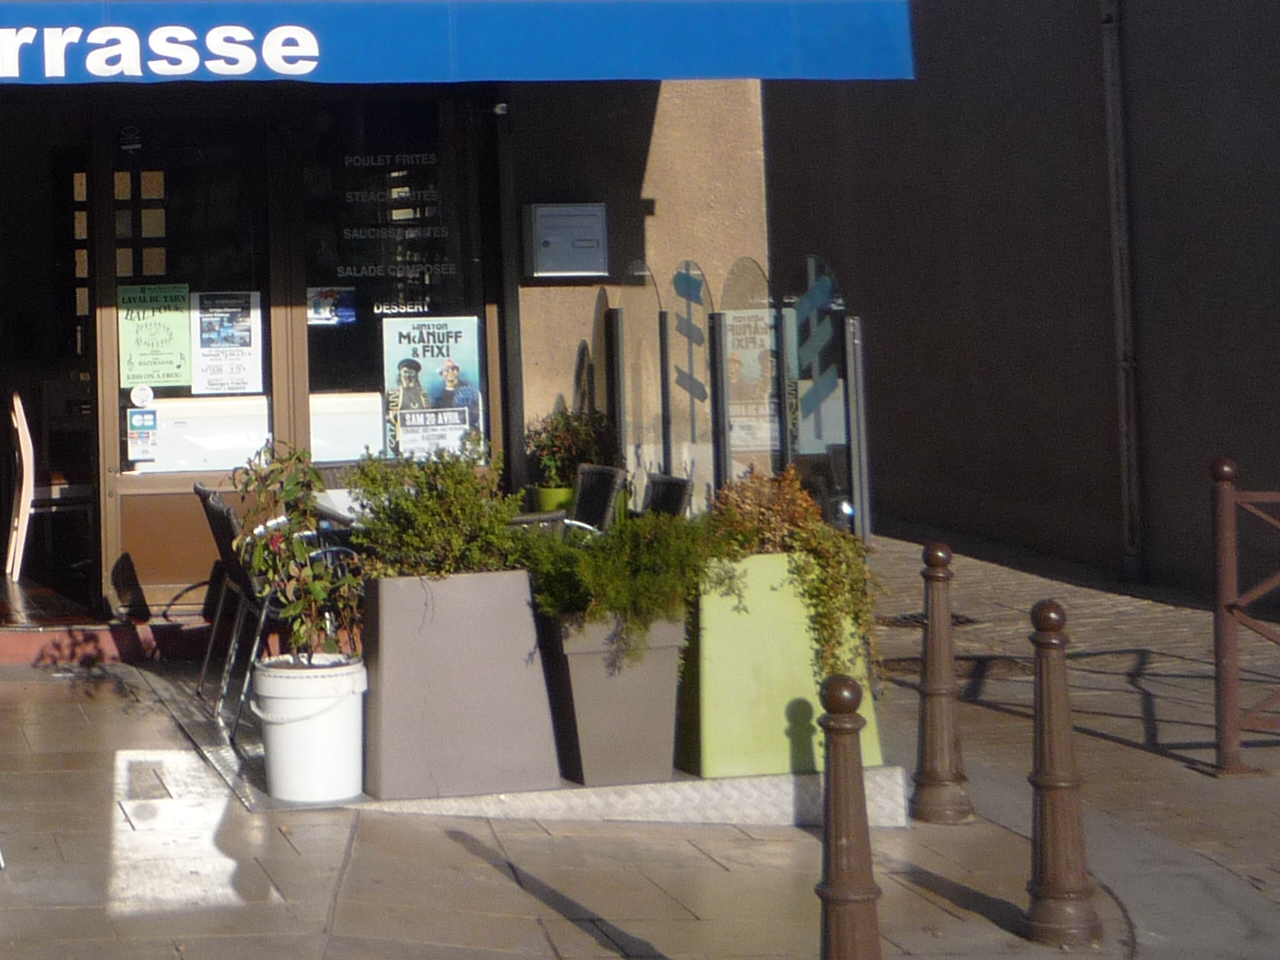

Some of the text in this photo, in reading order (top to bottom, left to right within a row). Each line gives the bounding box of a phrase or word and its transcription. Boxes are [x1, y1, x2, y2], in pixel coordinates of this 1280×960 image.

[344, 153, 437, 166] POULET FRITES
[337, 265, 385, 277] SALADE
[124, 307, 149, 321] BAL
[373, 302, 429, 314] DESSERT
[398, 331, 462, 344] McANUFF
[411, 345, 450, 358] & FIXI
[405, 411, 461, 426] SAM 20 AVRIL
